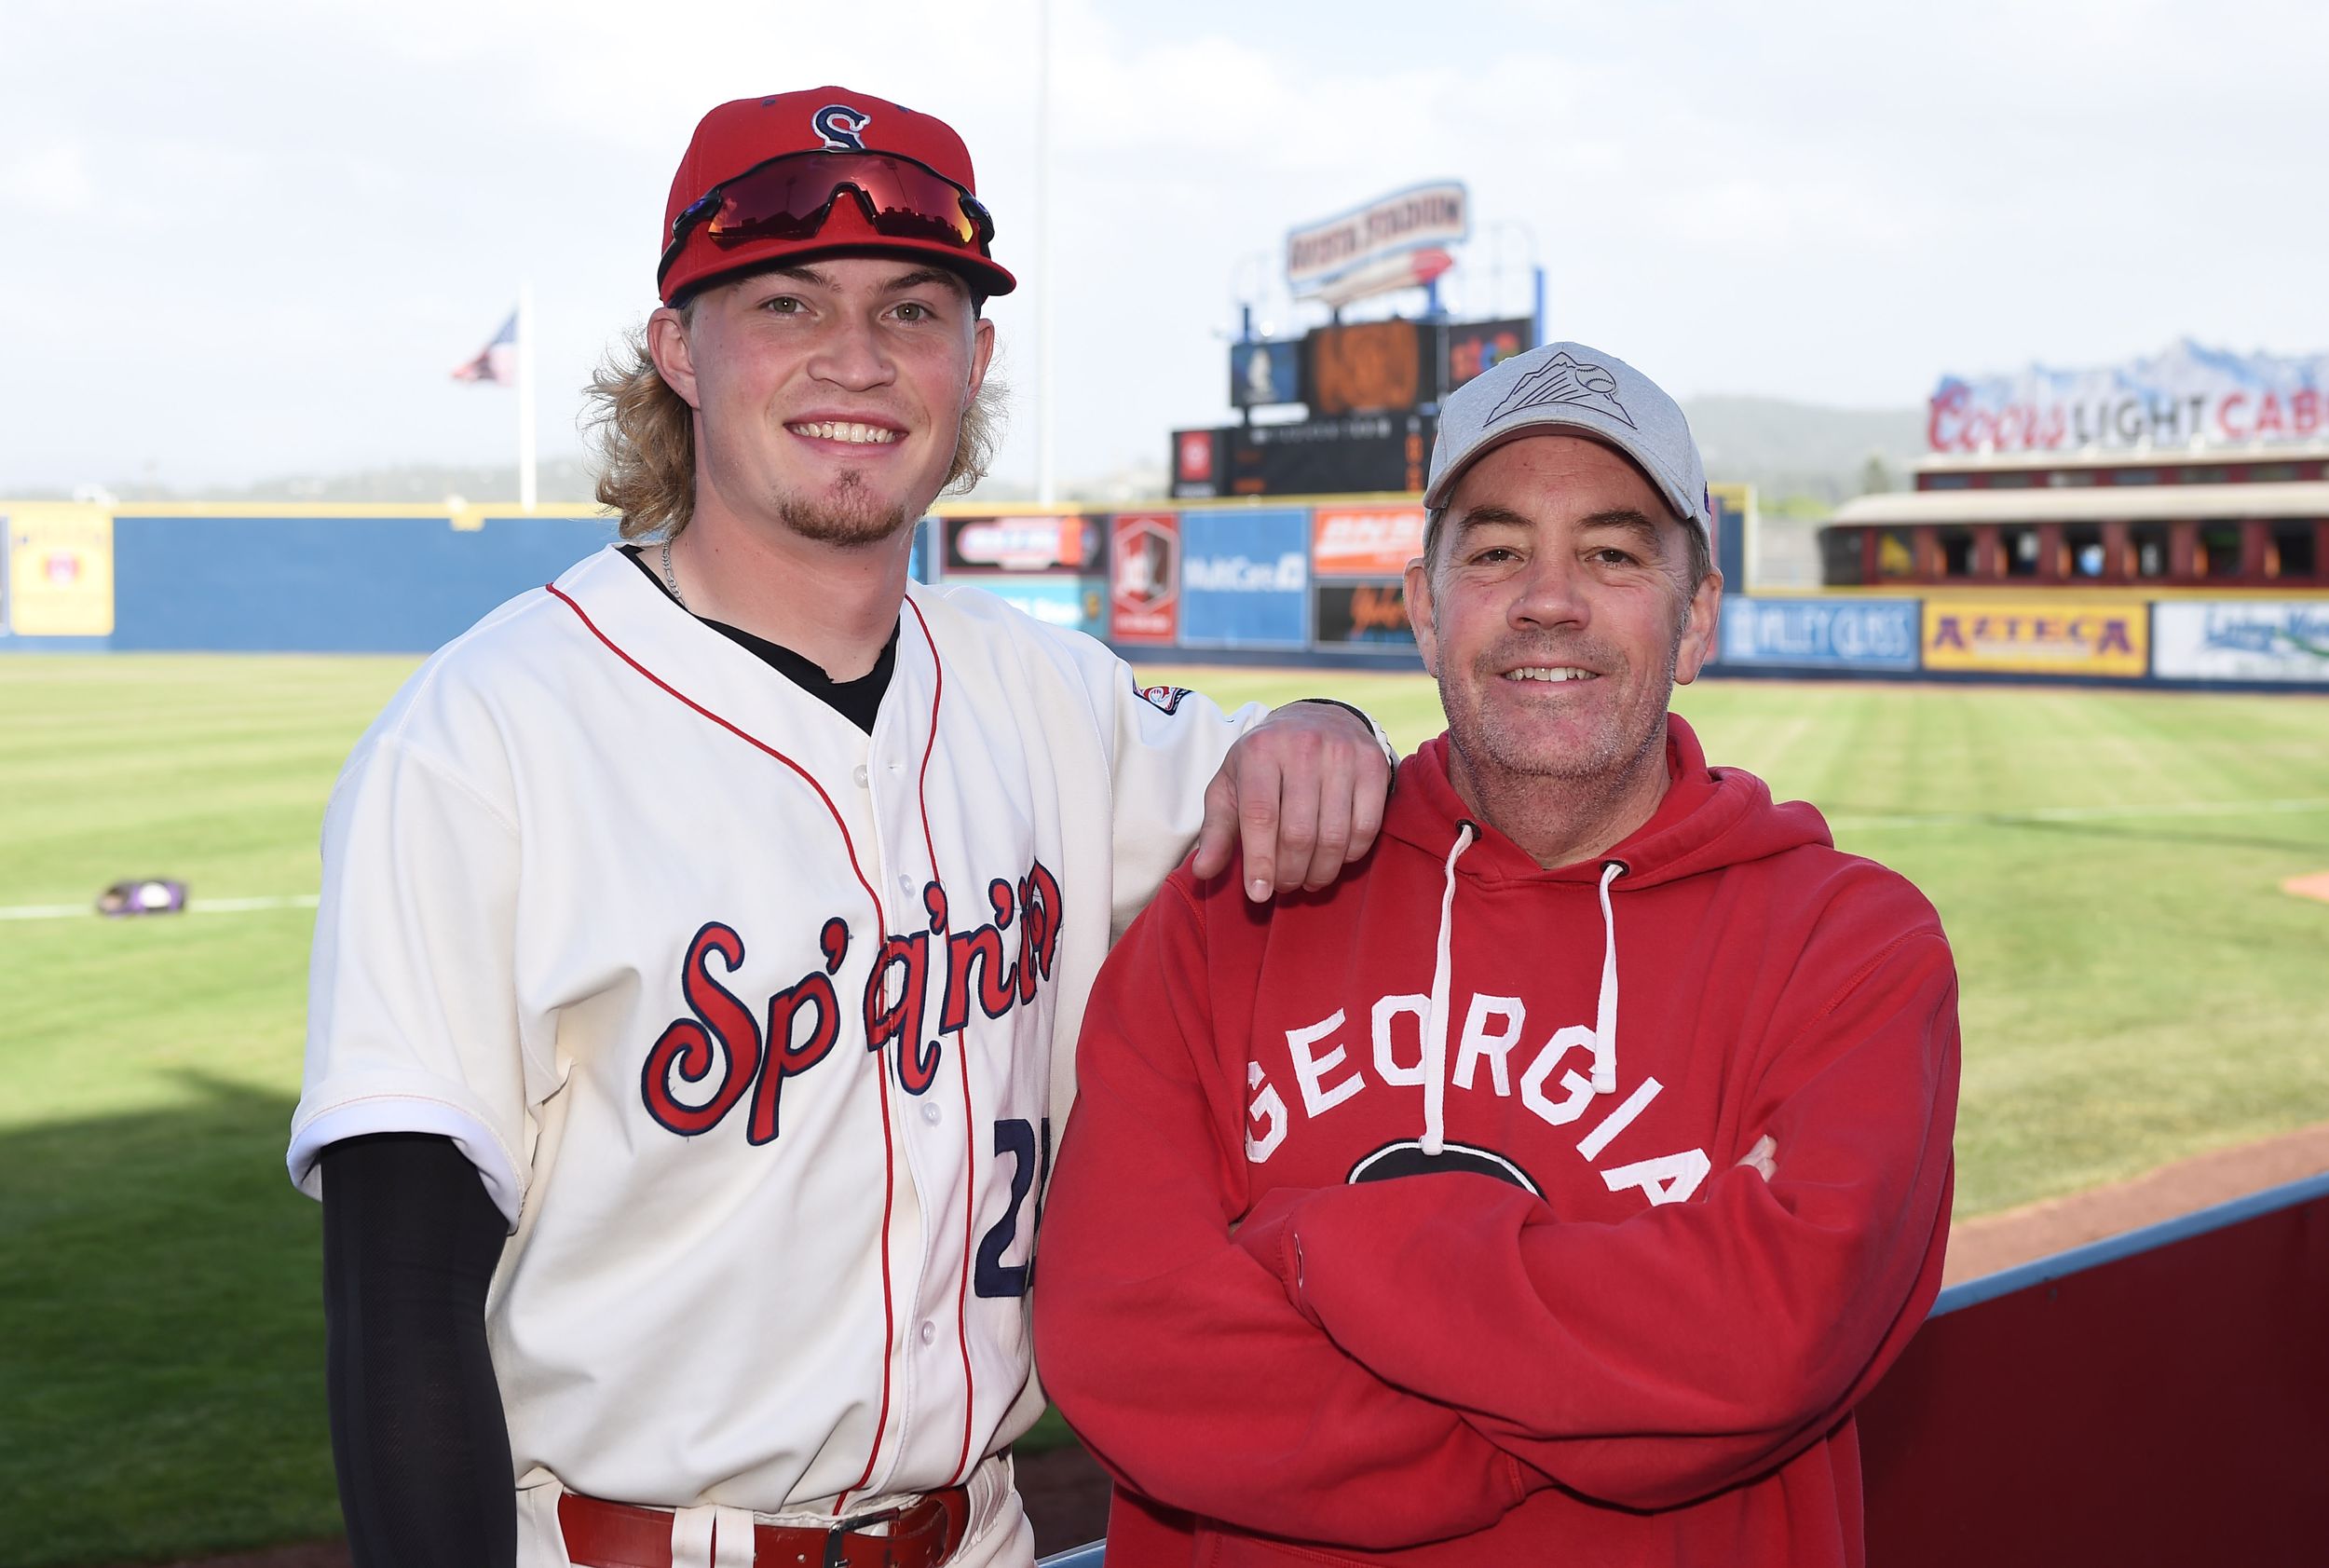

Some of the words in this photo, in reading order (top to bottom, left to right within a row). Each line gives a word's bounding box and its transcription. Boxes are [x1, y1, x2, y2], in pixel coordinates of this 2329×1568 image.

[1927, 382, 2067, 453] Coors
[2074, 393, 2208, 444] LIGHT
[2216, 388, 2329, 442] CAB
[1320, 516, 1423, 548] BNS
[1934, 615, 2134, 655] AZTECA
[1246, 991, 1712, 1207] GEORGIA
